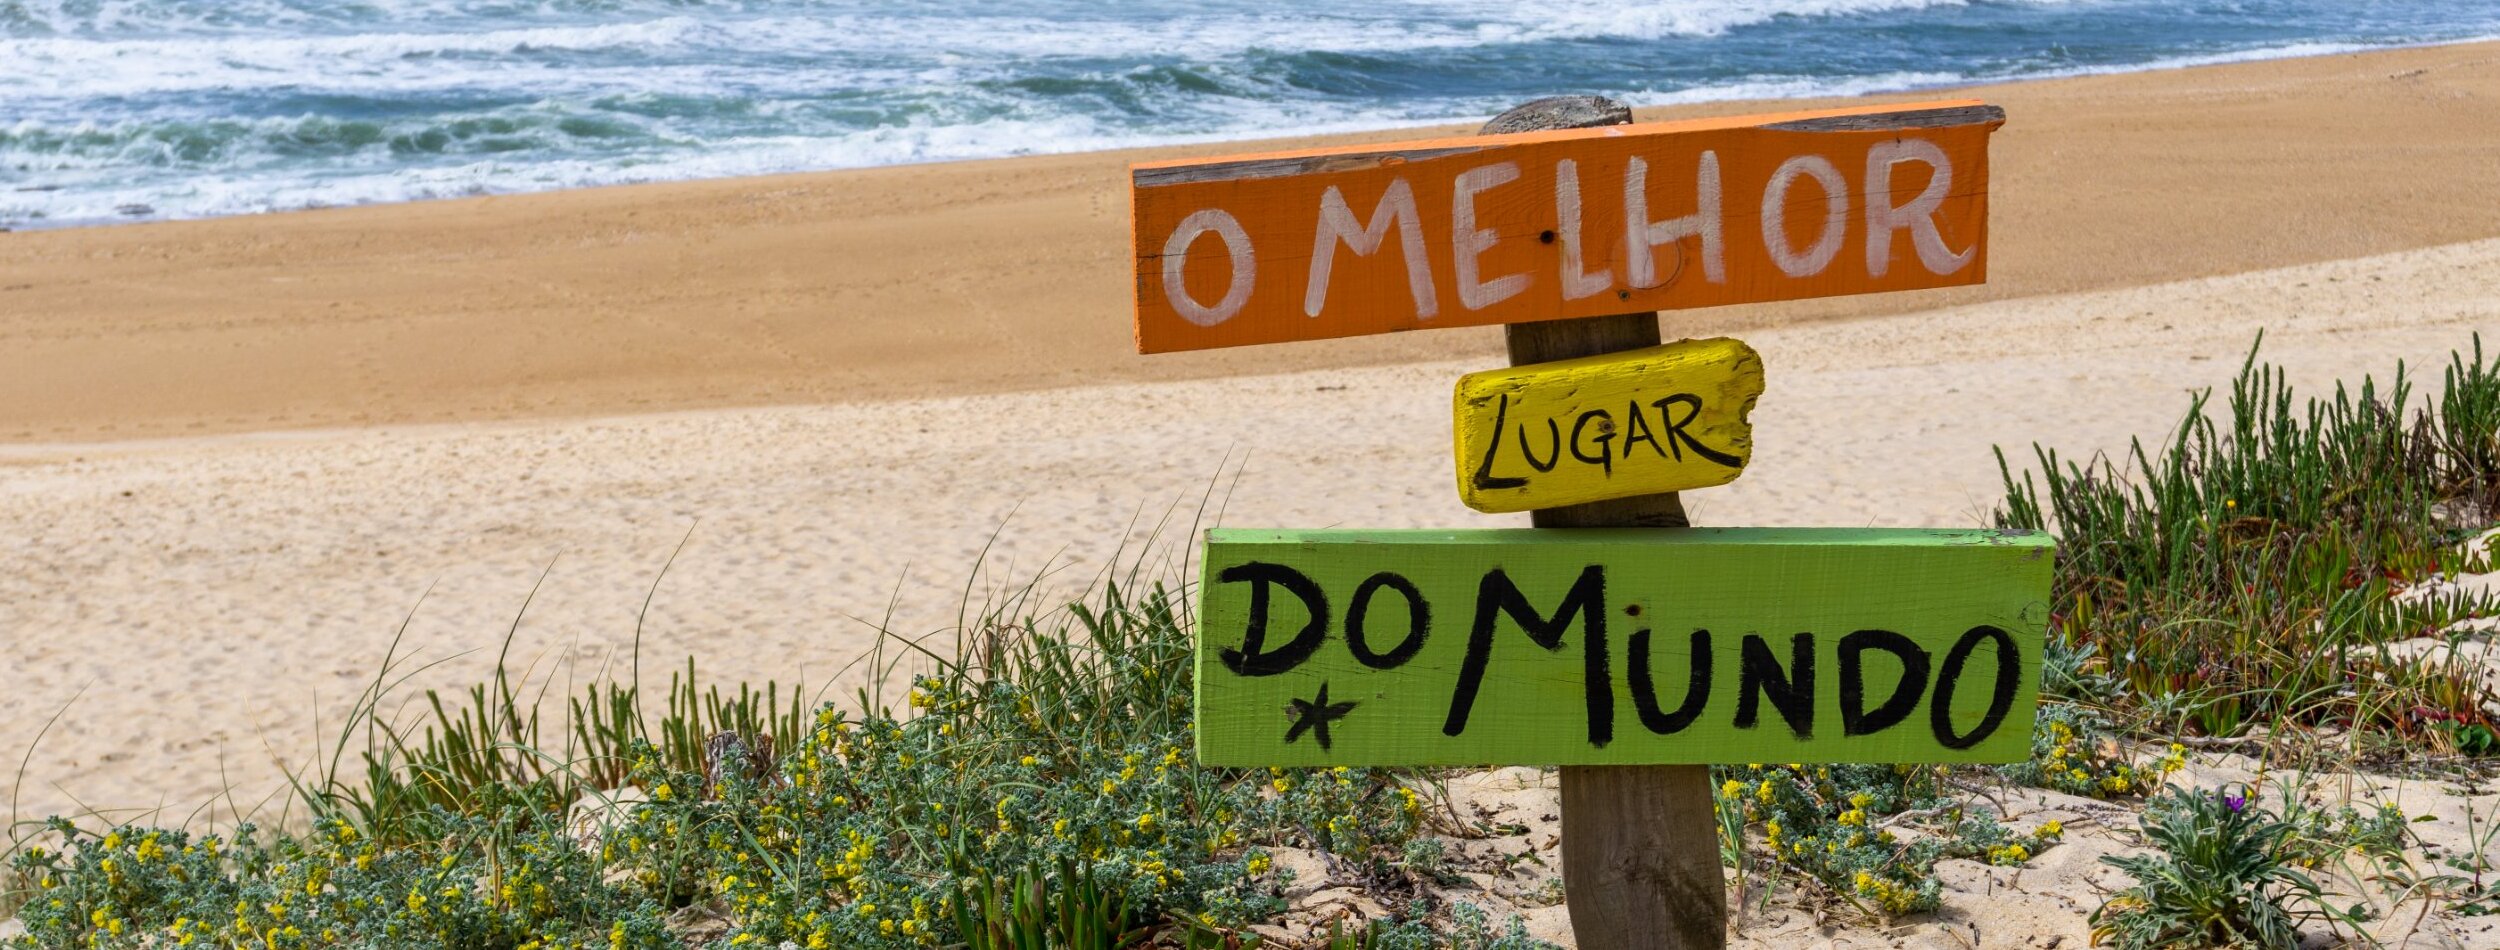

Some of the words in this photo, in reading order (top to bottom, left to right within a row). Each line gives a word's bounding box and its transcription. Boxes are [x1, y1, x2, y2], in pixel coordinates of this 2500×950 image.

[1162, 209, 1256, 326] O
[1303, 138, 1975, 320] MELHOR
[1474, 392, 1743, 490] LUGAR
[1217, 560, 1431, 677] DO
[1443, 564, 2022, 750] MUNDO
